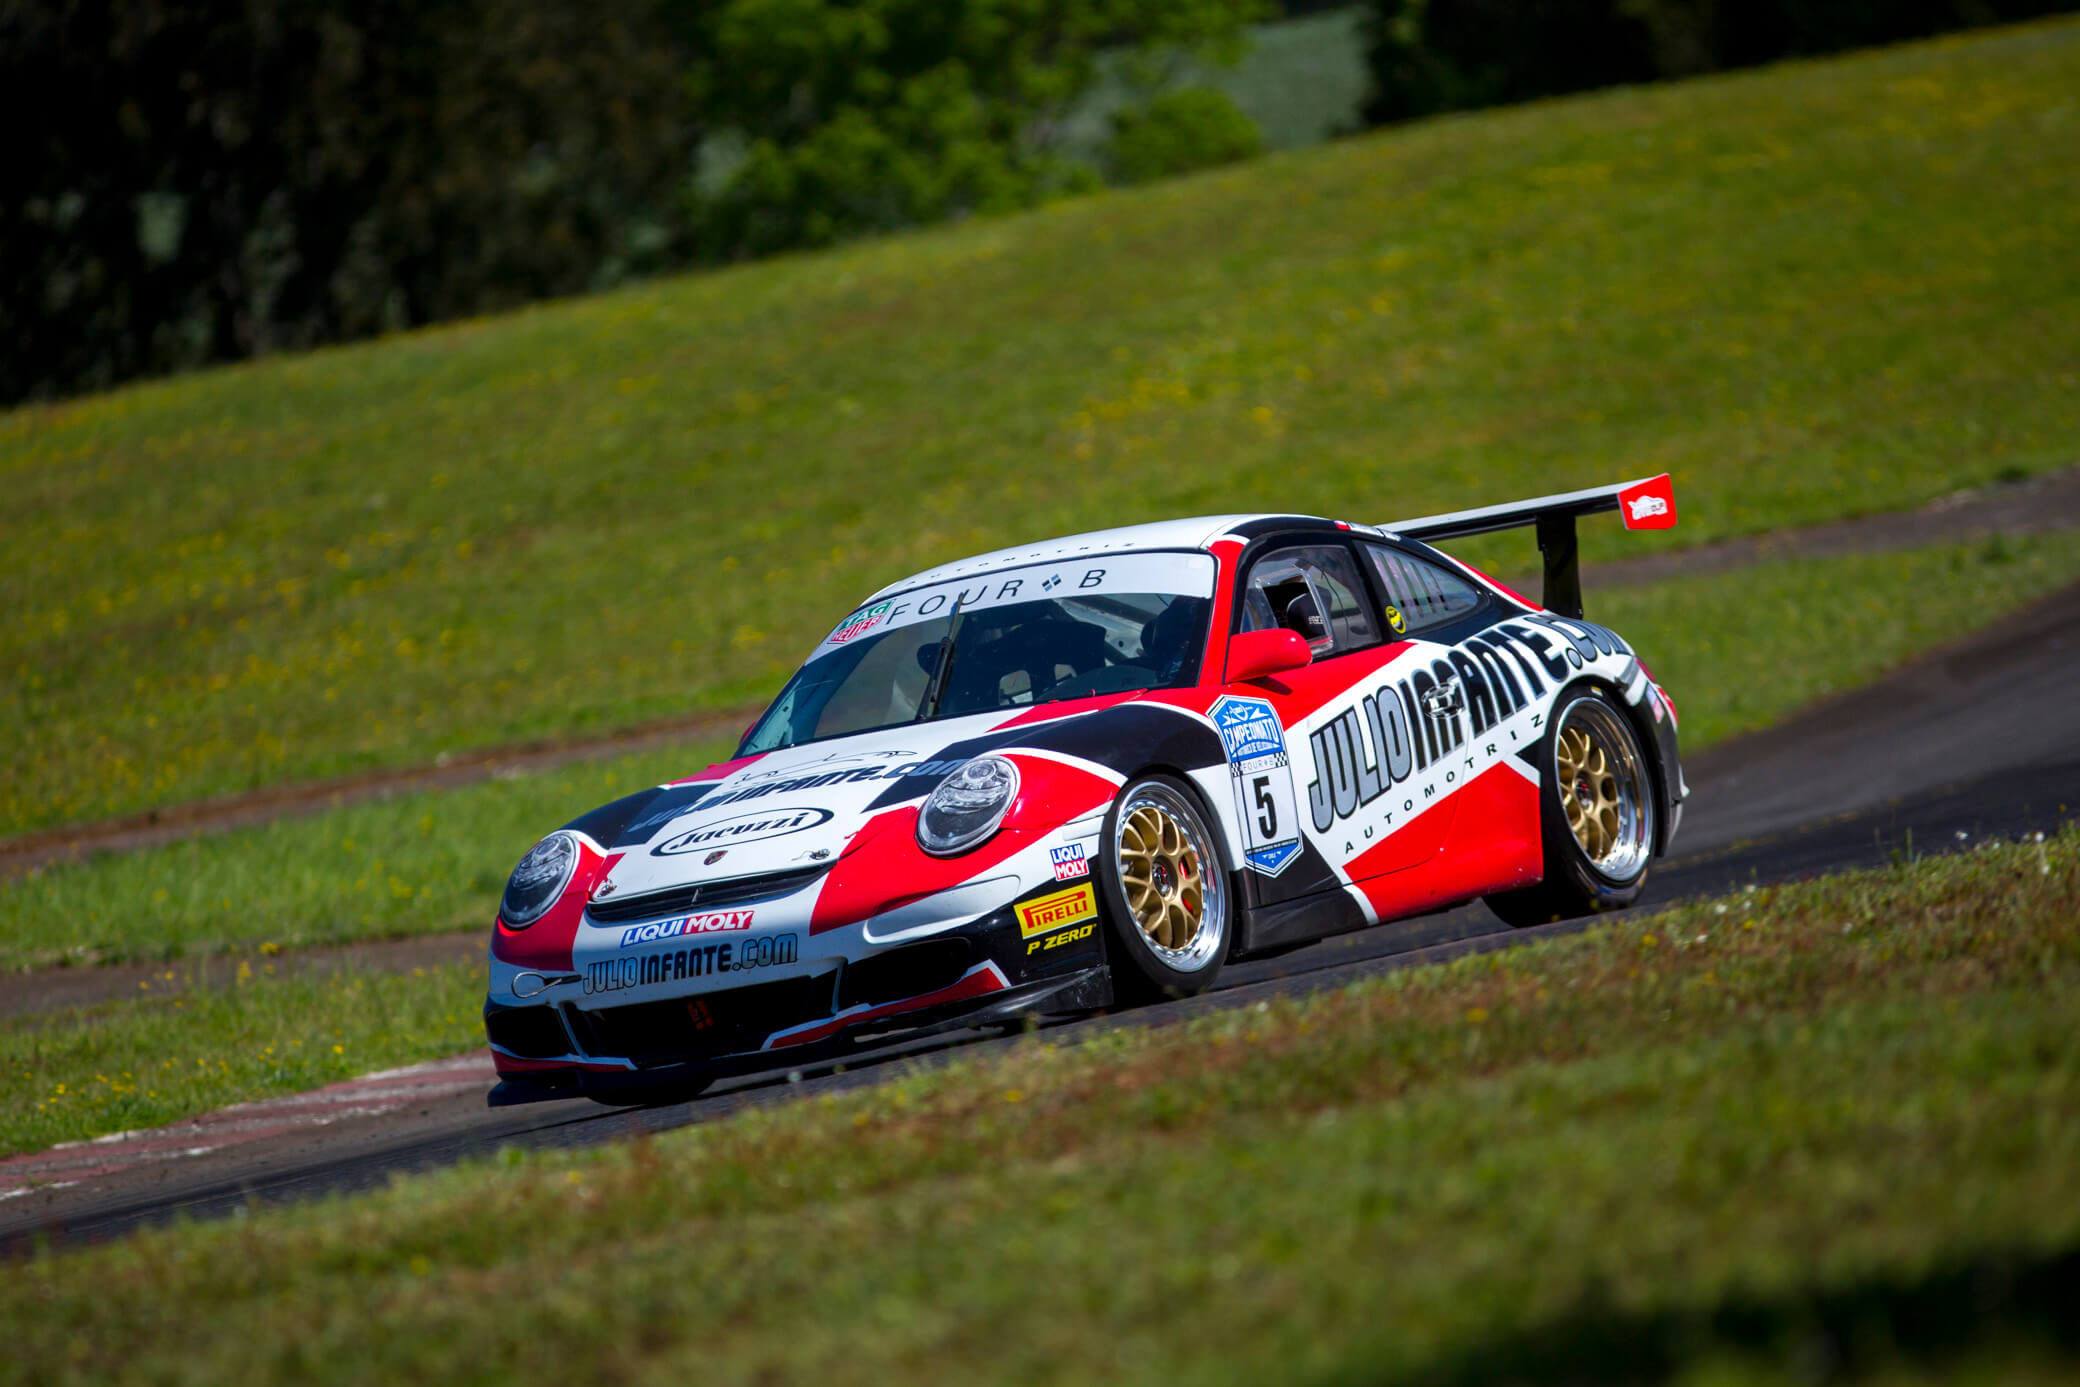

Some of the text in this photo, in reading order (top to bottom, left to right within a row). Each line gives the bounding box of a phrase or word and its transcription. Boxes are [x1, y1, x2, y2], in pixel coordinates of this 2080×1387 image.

[842, 601, 889, 626] TAG
[886, 569, 1107, 625] FOUR B
[830, 614, 881, 642] HEUER
[1344, 713, 1545, 855] AUTOMOTRIZ
[1253, 776, 1278, 840] 5
[668, 811, 811, 851] Jacuzzi
[1051, 844, 1085, 865] LIQUI
[1055, 860, 1087, 879] MOLY
[1022, 891, 1088, 929] PIRELLI
[623, 911, 754, 946] LIQUI MOLY
[1026, 924, 1094, 956] P ZERO
